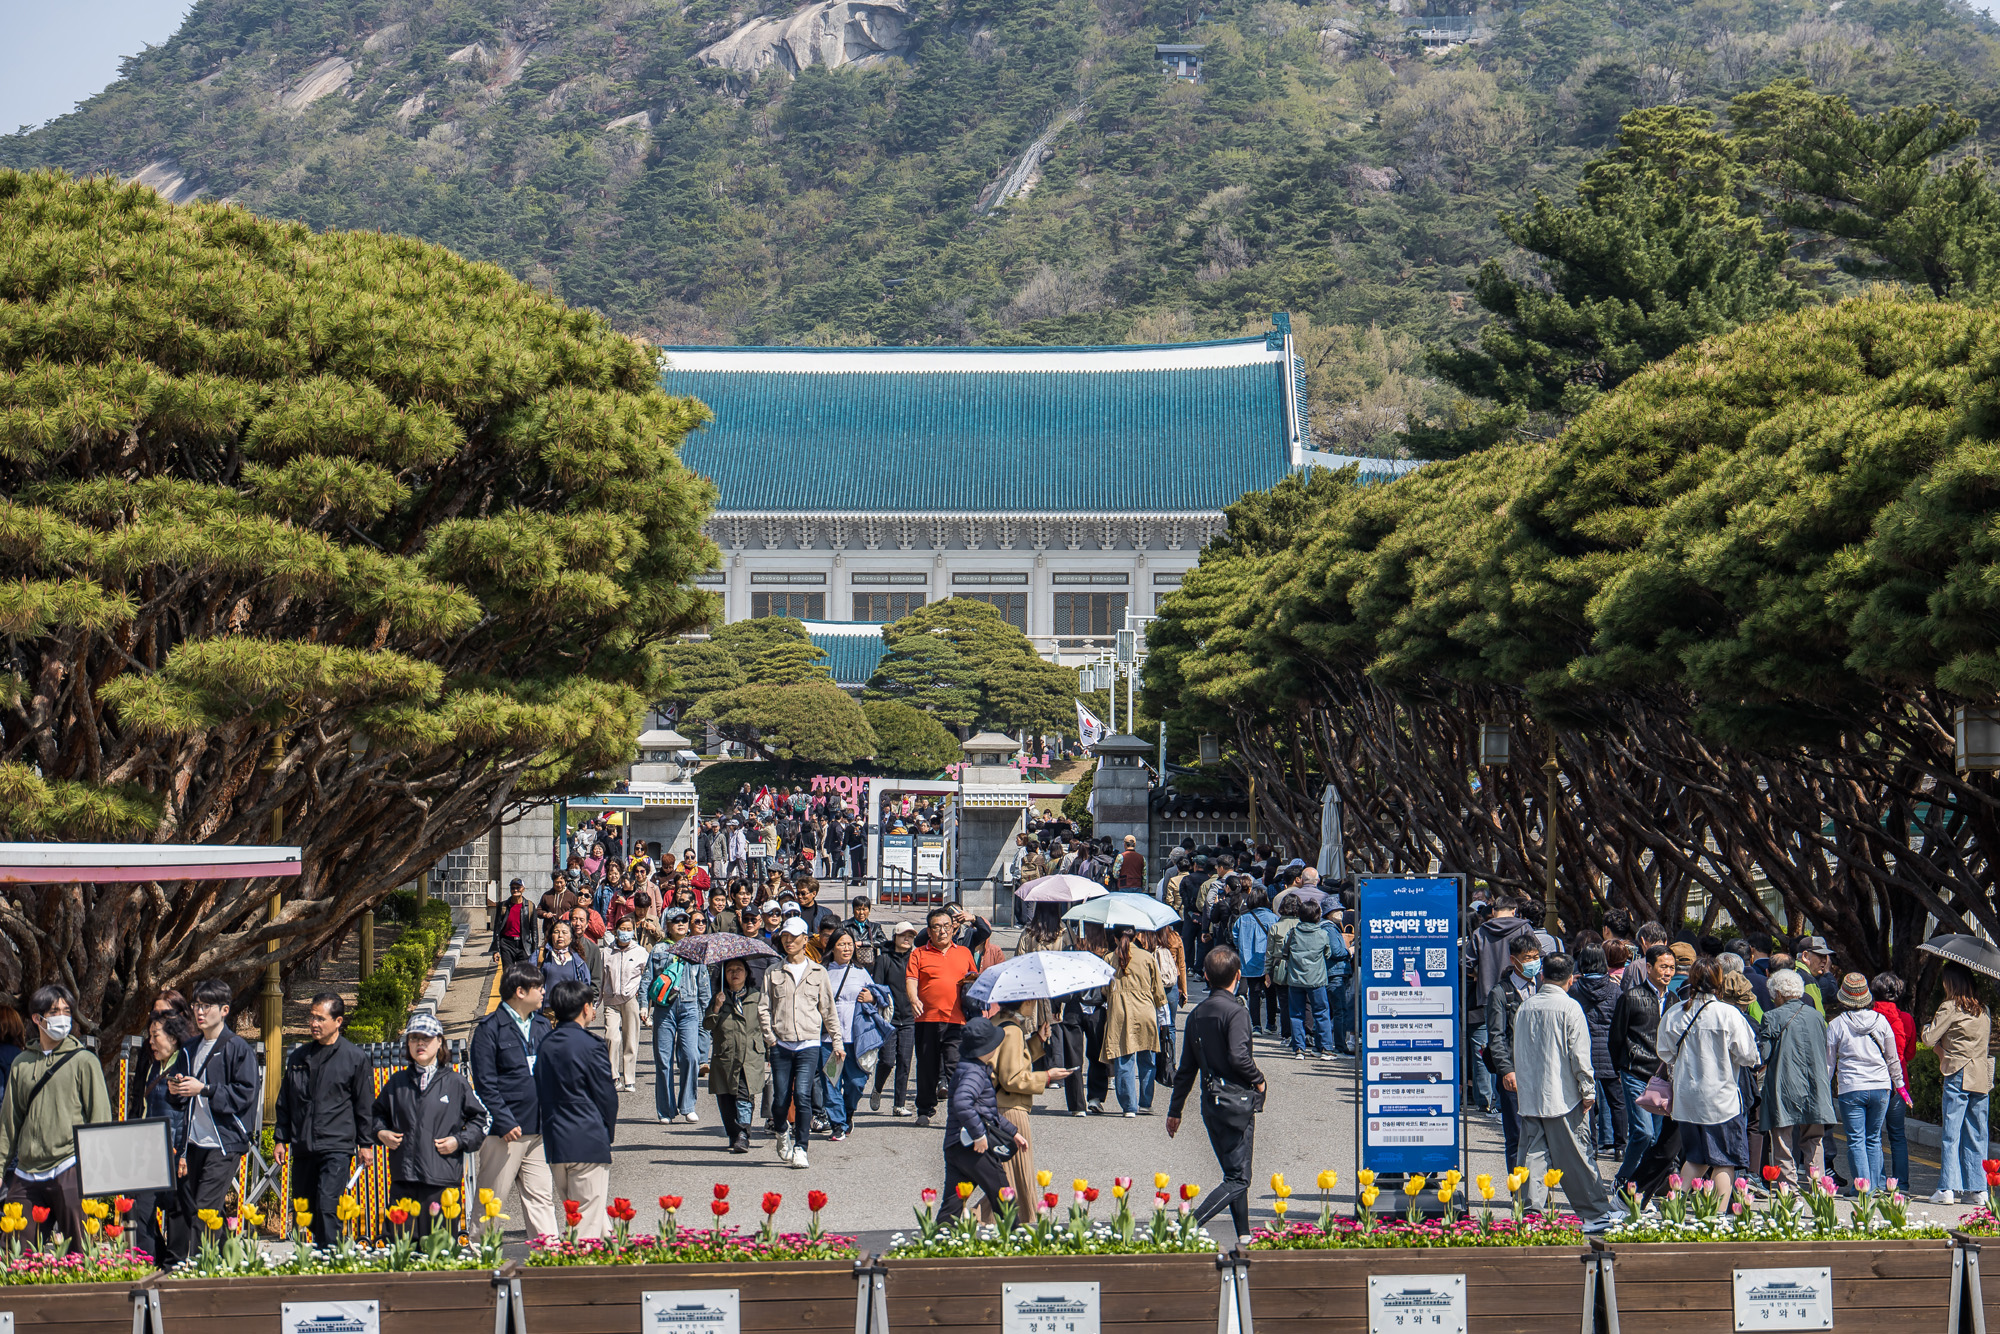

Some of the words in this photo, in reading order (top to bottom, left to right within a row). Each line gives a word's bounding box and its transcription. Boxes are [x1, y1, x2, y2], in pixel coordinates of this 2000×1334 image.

[1369, 919, 1420, 933] 현장예약
[1424, 919, 1449, 933] 방법
[1761, 1309, 1806, 1319] 청와대
[1395, 1315, 1441, 1325] 청와대
[1030, 1323, 1075, 1332] 청와대
